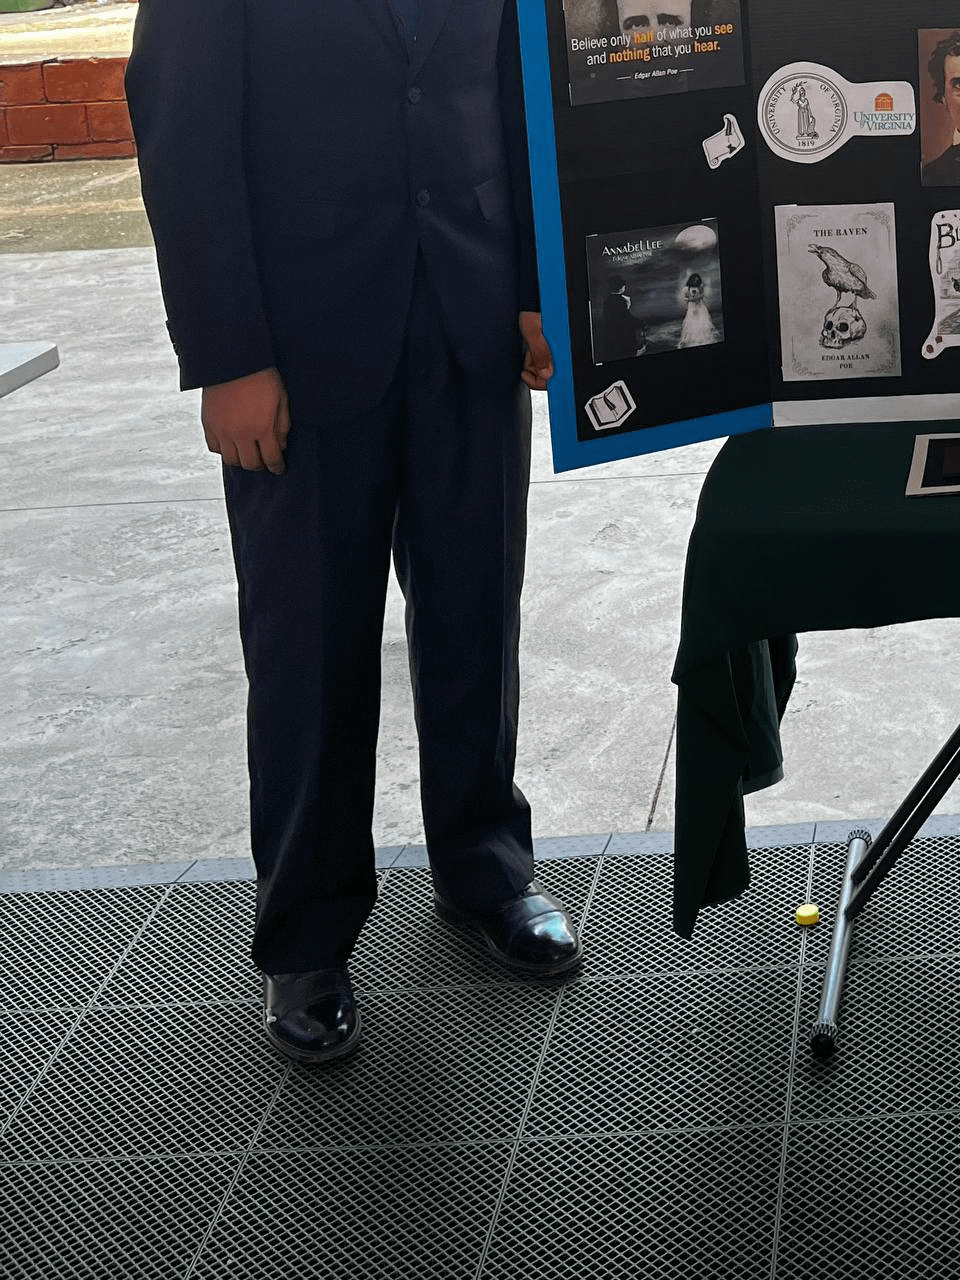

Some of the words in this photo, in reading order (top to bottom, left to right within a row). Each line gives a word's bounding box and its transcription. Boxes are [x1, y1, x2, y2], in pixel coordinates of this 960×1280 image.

[571, 37, 608, 51] Believe
[610, 32, 632, 48] only
[633, 30, 654, 44] half
[656, 28, 668, 41] of
[668, 26, 694, 40] what
[694, 25, 712, 39] you
[714, 23, 733, 35] see
[587, 52, 607, 66] and
[609, 47, 651, 63] nothing
[651, 45, 673, 58] that
[674, 43, 692, 58] you
[694, 40, 721, 53] hear.
[634, 71, 651, 80] Edgar
[651, 69, 666, 78] Allan
[667, 68, 678, 76] Poe
[768, 84, 788, 136] UNIVERSITY
[819, 84, 830, 93] OF
[829, 94, 842, 134] VIRGINIA
[853, 111, 915, 122] UNIVERSITY
[865, 120, 913, 131] VIRGINIA
[813, 228, 834, 238] THE
[836, 227, 868, 237] RAVEN
[646, 240, 662, 250] LEE
